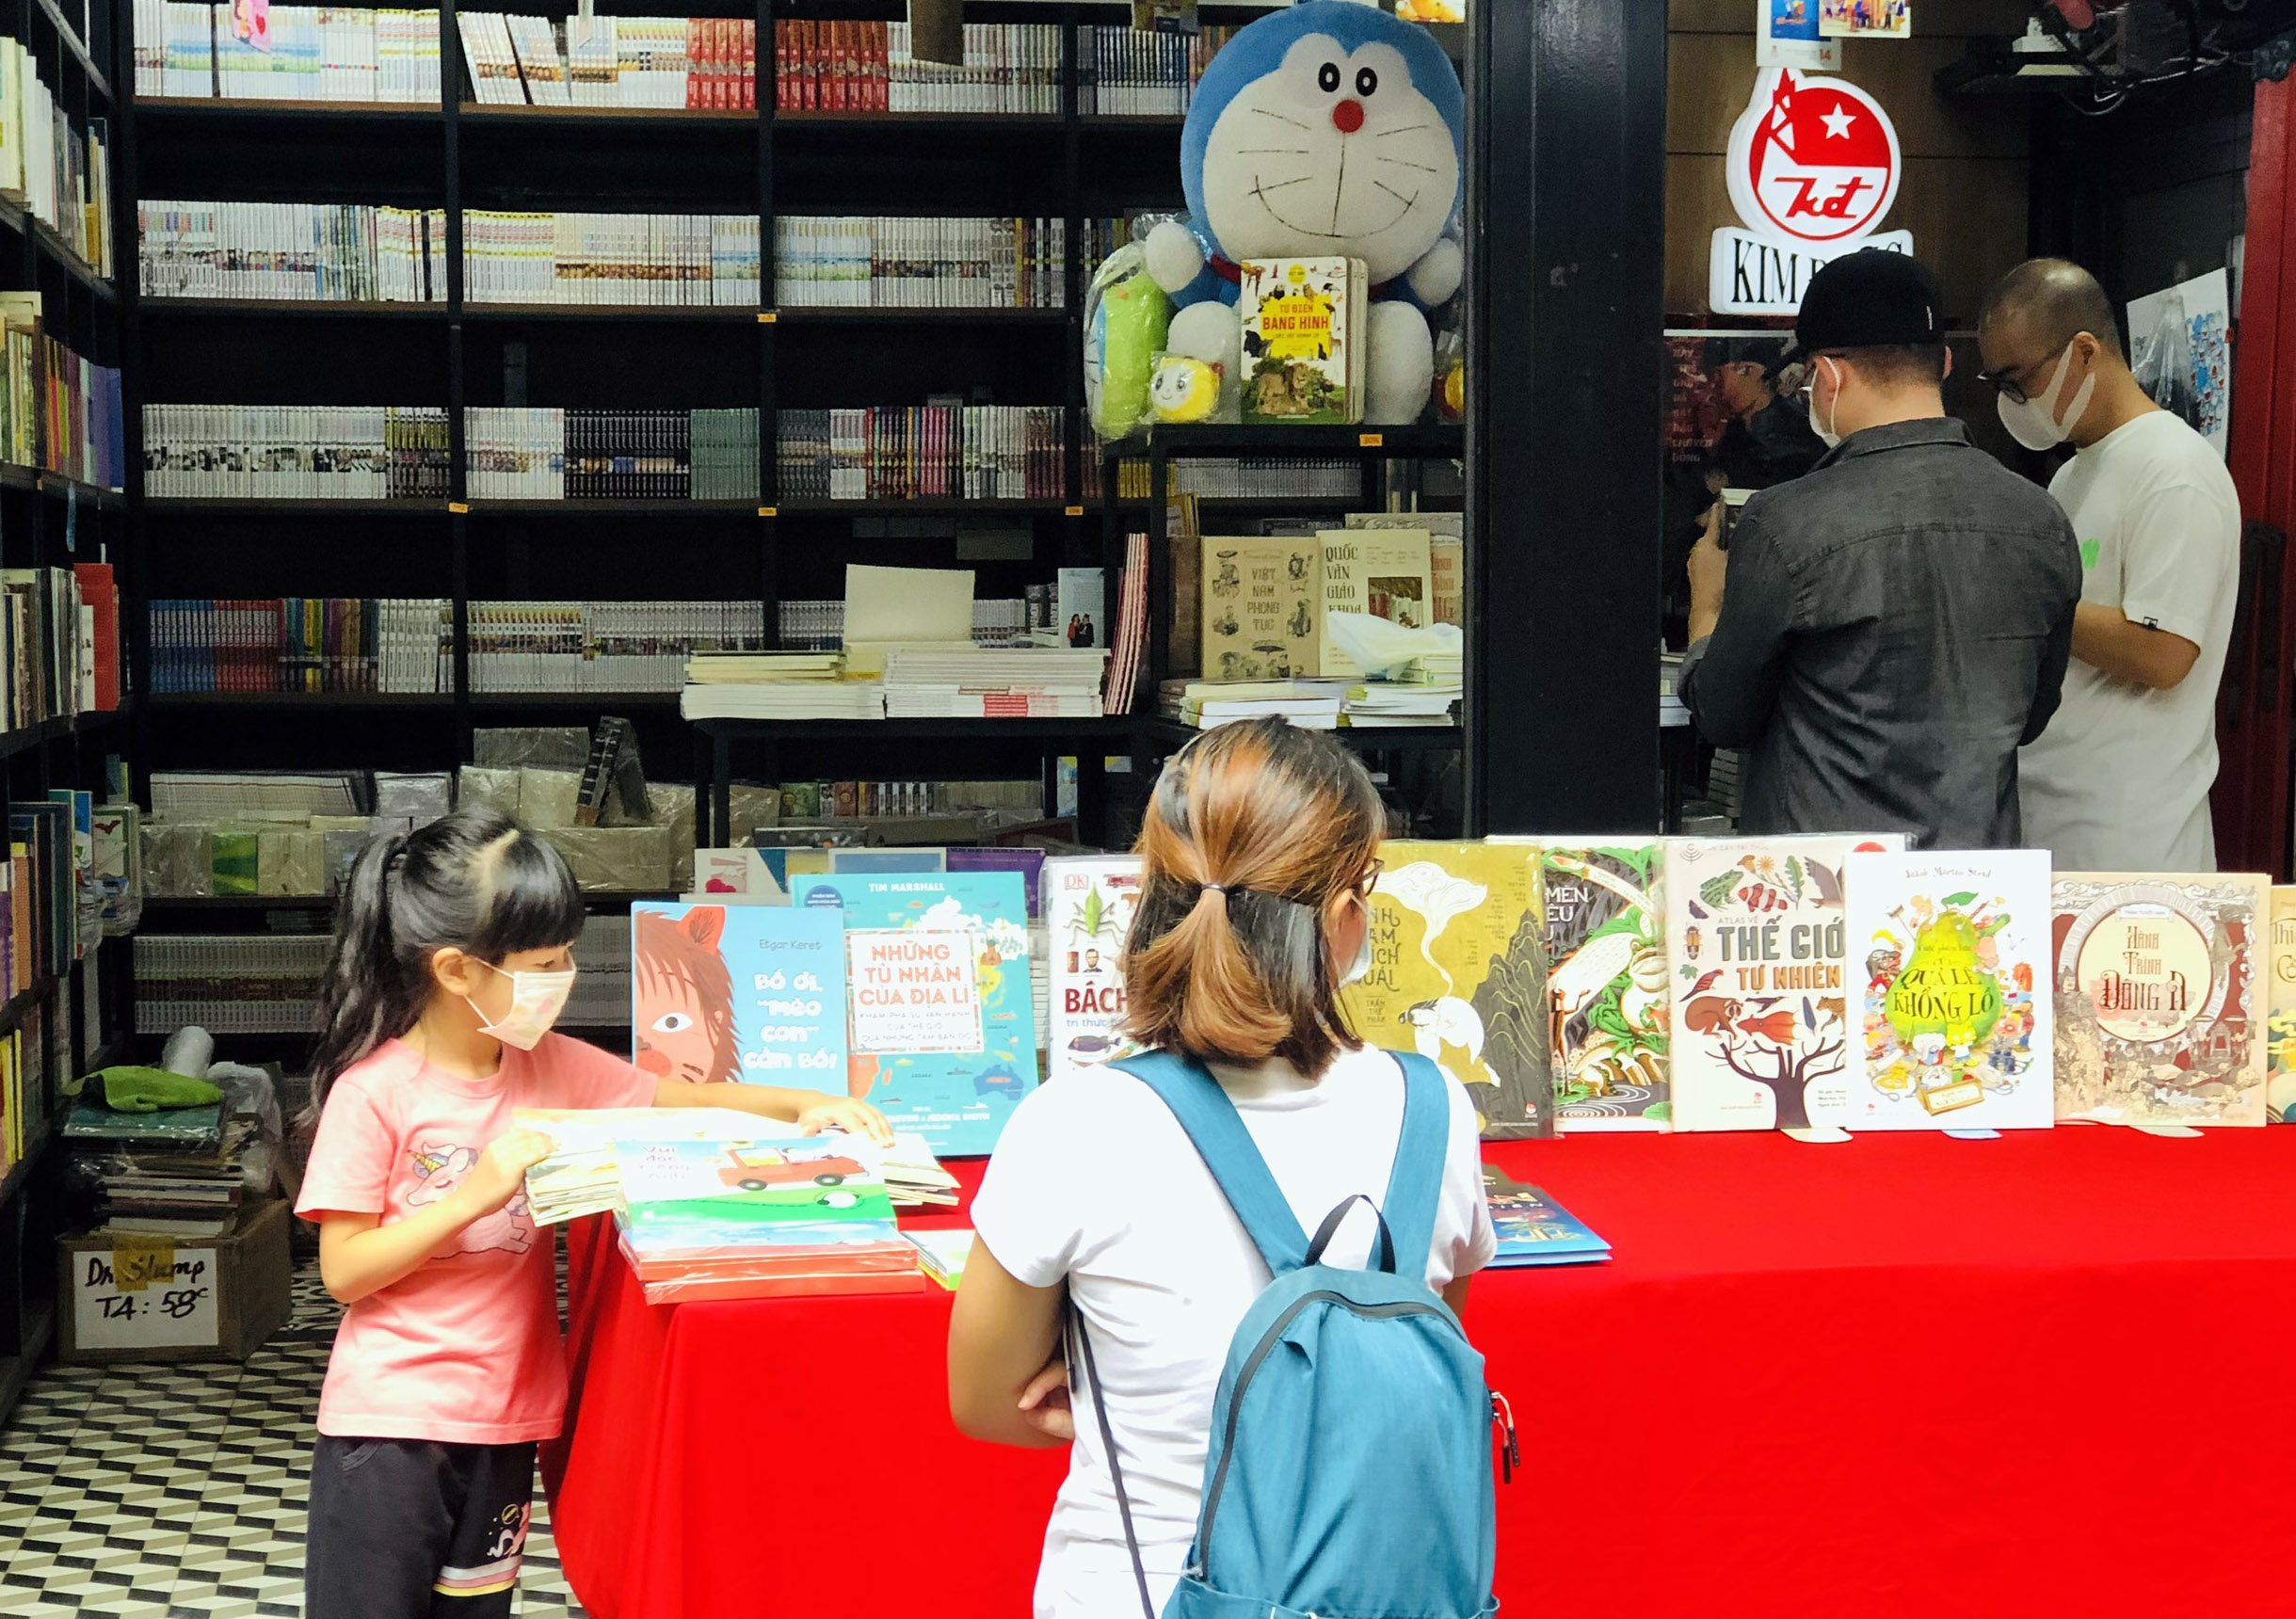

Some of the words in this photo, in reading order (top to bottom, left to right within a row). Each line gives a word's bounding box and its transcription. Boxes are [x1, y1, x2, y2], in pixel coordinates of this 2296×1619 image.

[1731, 237, 1800, 304] KIM
[1325, 541, 1358, 562] QUỐC
[1326, 564, 1350, 580] VĂN
[1252, 585, 1275, 598] NAM
[1326, 582, 1356, 600] GIÁO
[1246, 601, 1280, 614] PHONG
[868, 882, 888, 892] TIM
[891, 882, 945, 892] MARSHALL
[1066, 873, 1088, 889] DK
[1546, 904, 1574, 922] ÊU
[1717, 916, 1746, 925] ATLAS
[759, 938, 788, 951] Etgar
[790, 939, 822, 951] Keret
[1370, 928, 1396, 944] AM
[1716, 914, 1783, 962] THẾ
[1790, 916, 1846, 960] GIỚ
[871, 939, 951, 961] NHỮNG
[898, 962, 961, 983] NHÂN
[1365, 966, 1401, 992] UÁI
[1736, 964, 1766, 995] TỰ
[1773, 961, 1840, 990] NHIÊN
[910, 987, 947, 1008] ĐỊA
[1065, 980, 1129, 1014] BÁCH
